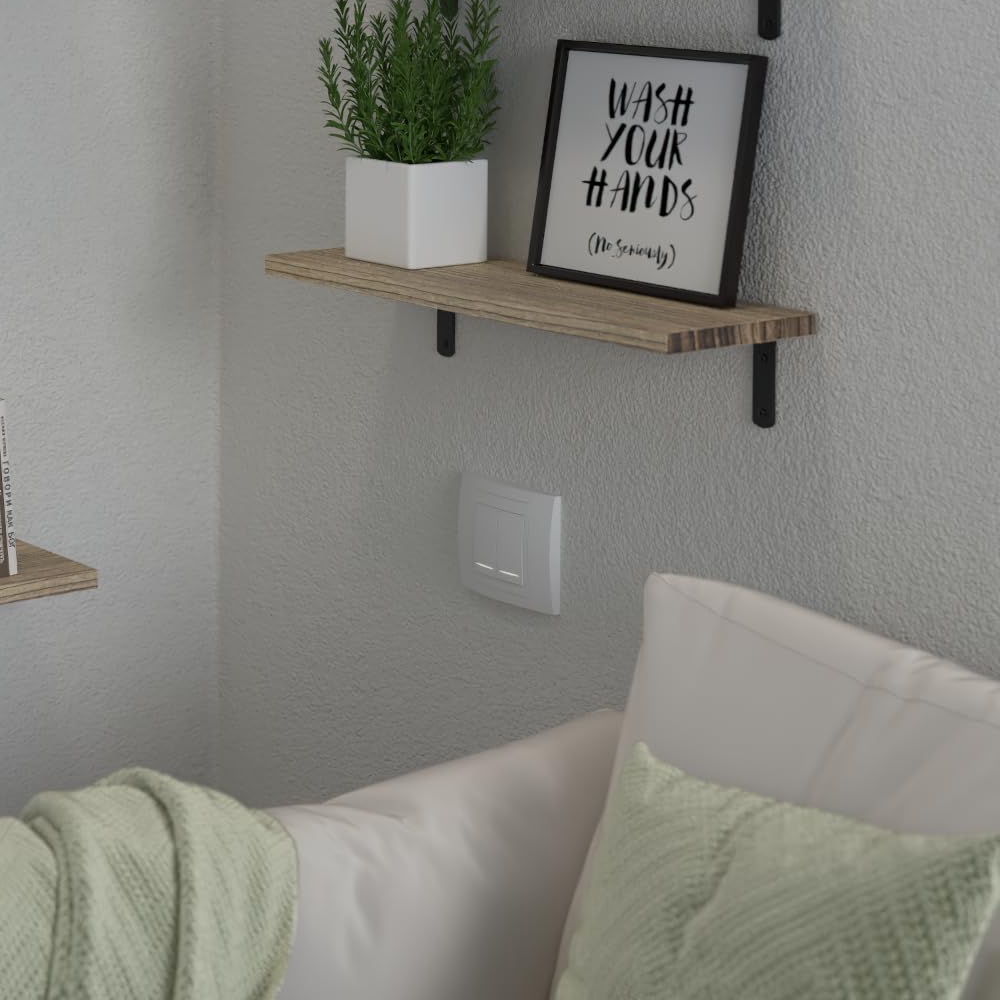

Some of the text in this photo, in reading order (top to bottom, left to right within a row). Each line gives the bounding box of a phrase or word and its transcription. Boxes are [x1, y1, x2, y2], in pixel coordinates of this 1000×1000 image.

[609, 78, 695, 127] WASH
[601, 122, 688, 170] YOUR
[581, 166, 697, 220] HANDS
[2, 460, 13, 507] ГОВОРИ
